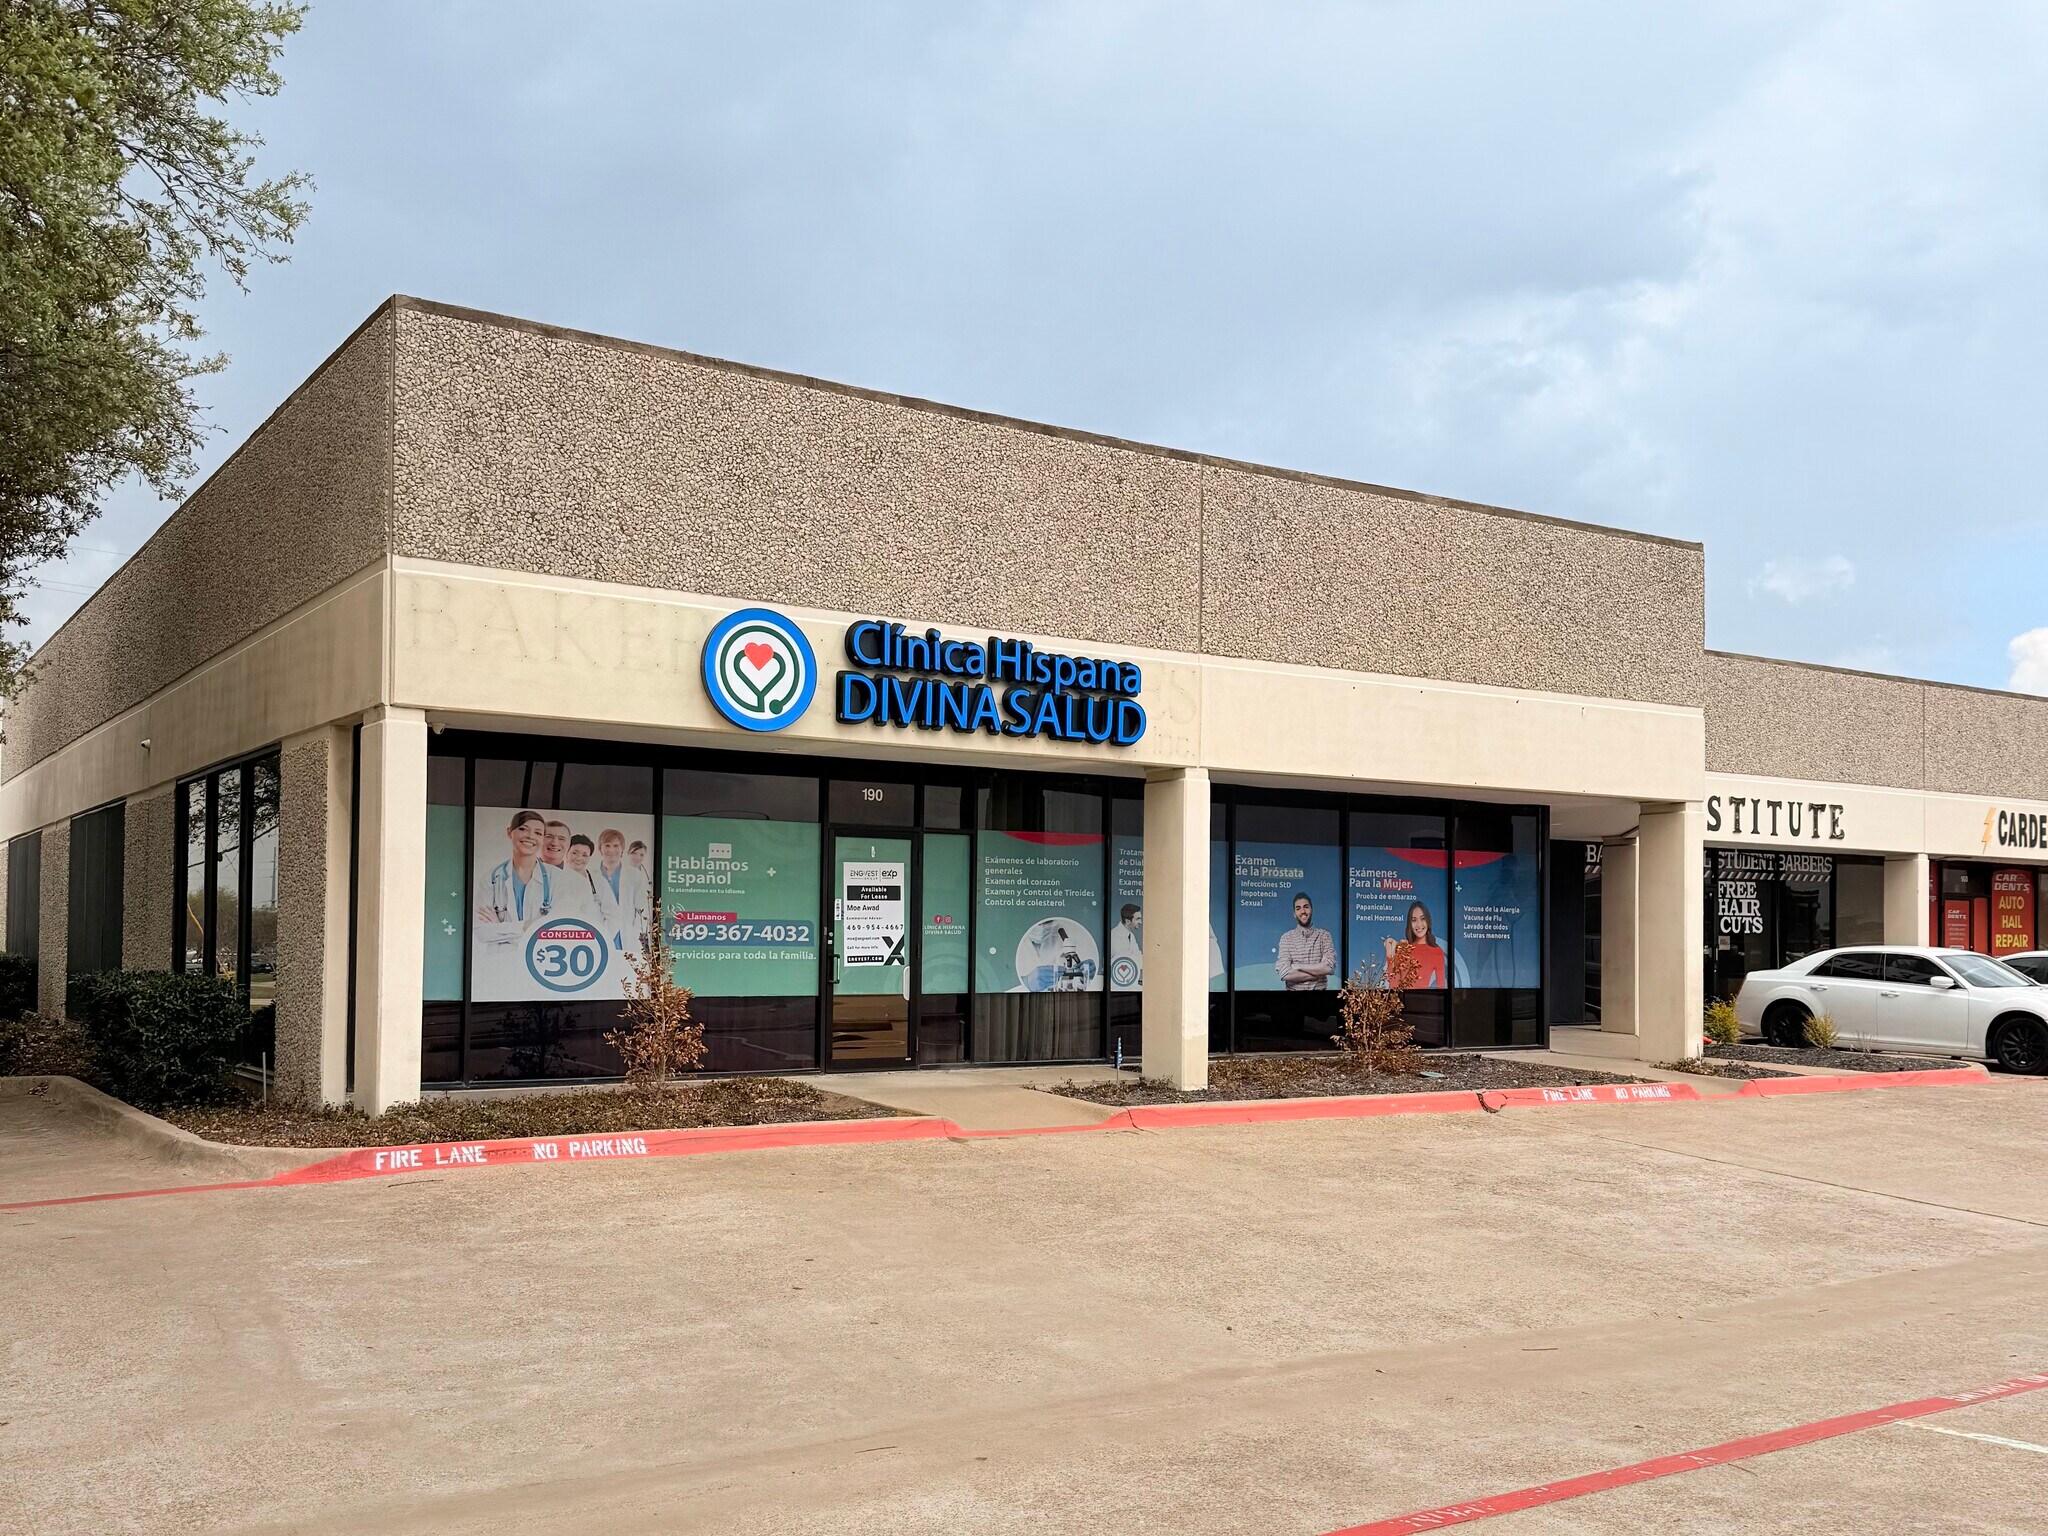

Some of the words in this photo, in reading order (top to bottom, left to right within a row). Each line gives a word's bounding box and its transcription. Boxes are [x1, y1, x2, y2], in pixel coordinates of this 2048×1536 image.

[847, 620, 985, 678] Clínica
[991, 637, 1142, 696] Hispana
[839, 672, 1001, 732] DIVINA
[1004, 688, 1147, 744] SALUD
[862, 788, 883, 801] 190
[1707, 795, 1845, 840] STITUTE
[1998, 810, 2047, 849] CARDE
[668, 856, 748, 872] Hablamos
[985, 856, 1024, 865] Exámenes
[1037, 858, 1079, 866] laboratorio
[1235, 855, 1276, 866] Examen
[1718, 850, 1776, 870] STUDENT
[1779, 854, 1832, 872] BARBERS
[668, 870, 732, 886] Español
[985, 867, 1023, 876] generales
[1235, 866, 1248, 875] de
[1250, 866, 1259, 876] la
[1262, 867, 1304, 878] Próstata
[1350, 868, 1397, 878] Exámenes
[1350, 878, 1370, 888] Para
[1373, 878, 1381, 888] la
[1384, 879, 1413, 890] Mujer.
[1718, 881, 1757, 898] FREE
[1994, 882, 2030, 892] DENTS
[1718, 899, 1761, 916] HAIR
[1999, 896, 2024, 909] AUTO
[1720, 916, 1764, 934] CUTS
[2002, 915, 2022, 928] HAIL
[668, 924, 810, 942] 469-367-4032
[1996, 934, 2028, 948] REPAIR
[536, 944, 594, 977] $30
[668, 951, 716, 959] Servicios
[719, 952, 741, 960] para
[744, 951, 766, 960] toda
[769, 951, 778, 959] la
[780, 951, 817, 960] familia.
[1542, 1089, 1568, 1102] FIRE
[1571, 1088, 1596, 1100] LANE
[1614, 1087, 1628, 1099] NO
[1631, 1086, 1670, 1098] PARKING
[375, 1149, 423, 1171] FIRE
[435, 1146, 487, 1166] LANE
[533, 1142, 558, 1160] NO
[569, 1138, 647, 1159] PARKING
